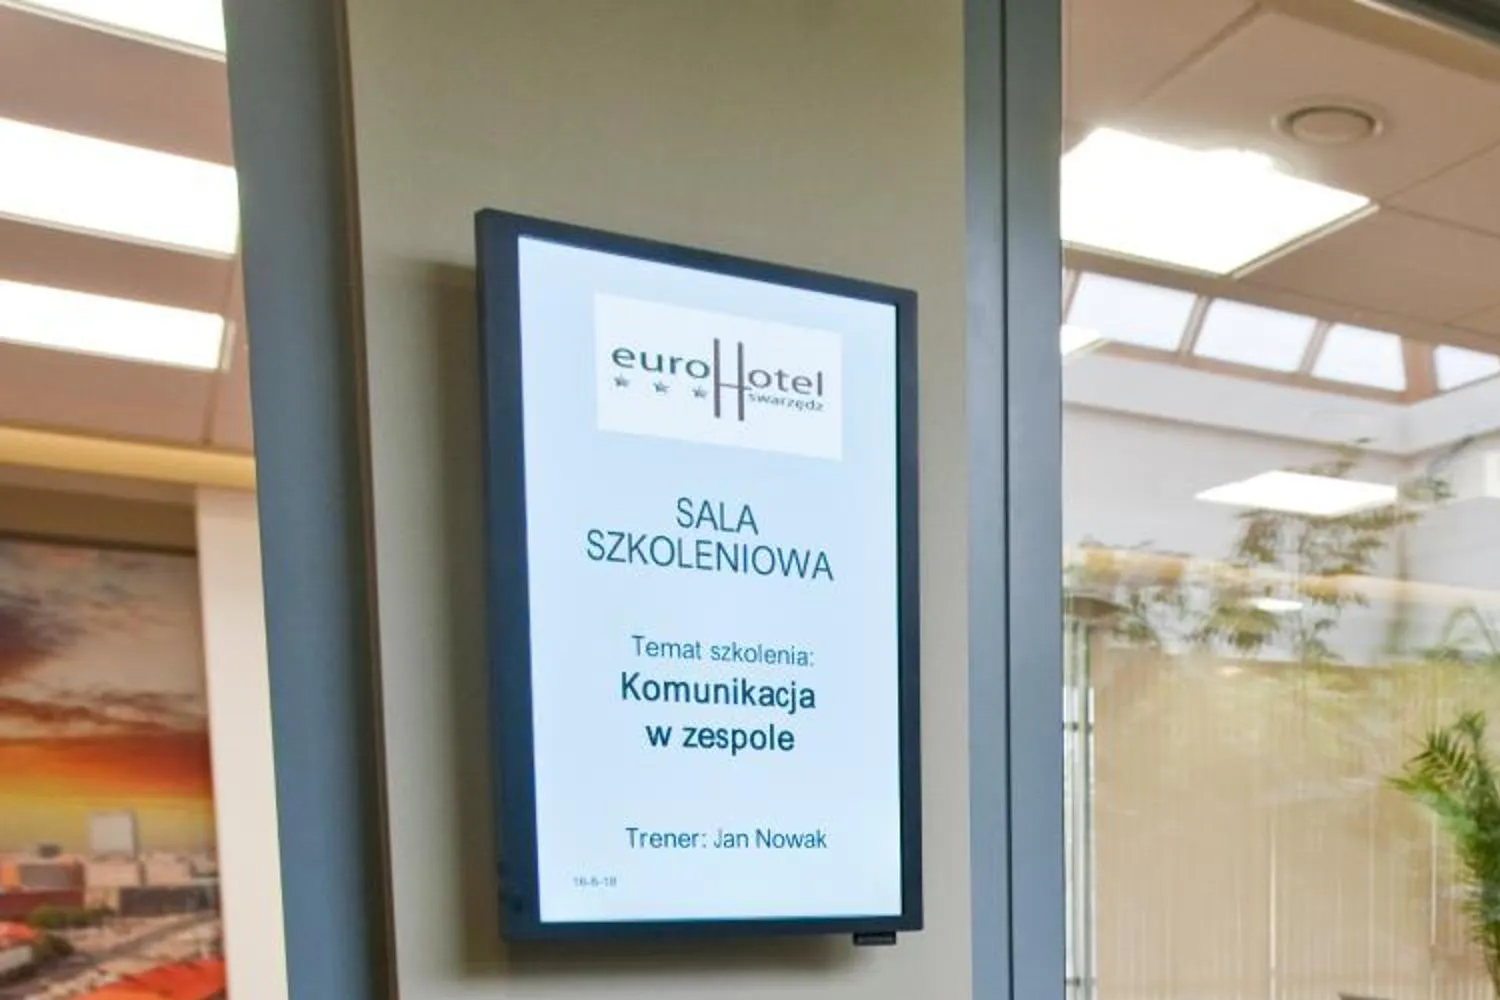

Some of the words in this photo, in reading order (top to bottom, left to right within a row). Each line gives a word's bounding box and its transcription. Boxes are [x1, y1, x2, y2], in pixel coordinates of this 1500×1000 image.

[676, 497, 758, 535] SALA
[586, 529, 834, 581] SZKOLENIOWA
[632, 635, 701, 660] Temat
[710, 640, 815, 667] szkolenia:
[621, 671, 816, 715] Komunikacja
[646, 724, 672, 747] w
[682, 723, 795, 757] zespole
[625, 827, 706, 849] Trener:
[713, 828, 749, 849] Jan
[756, 828, 828, 849] Nowak
